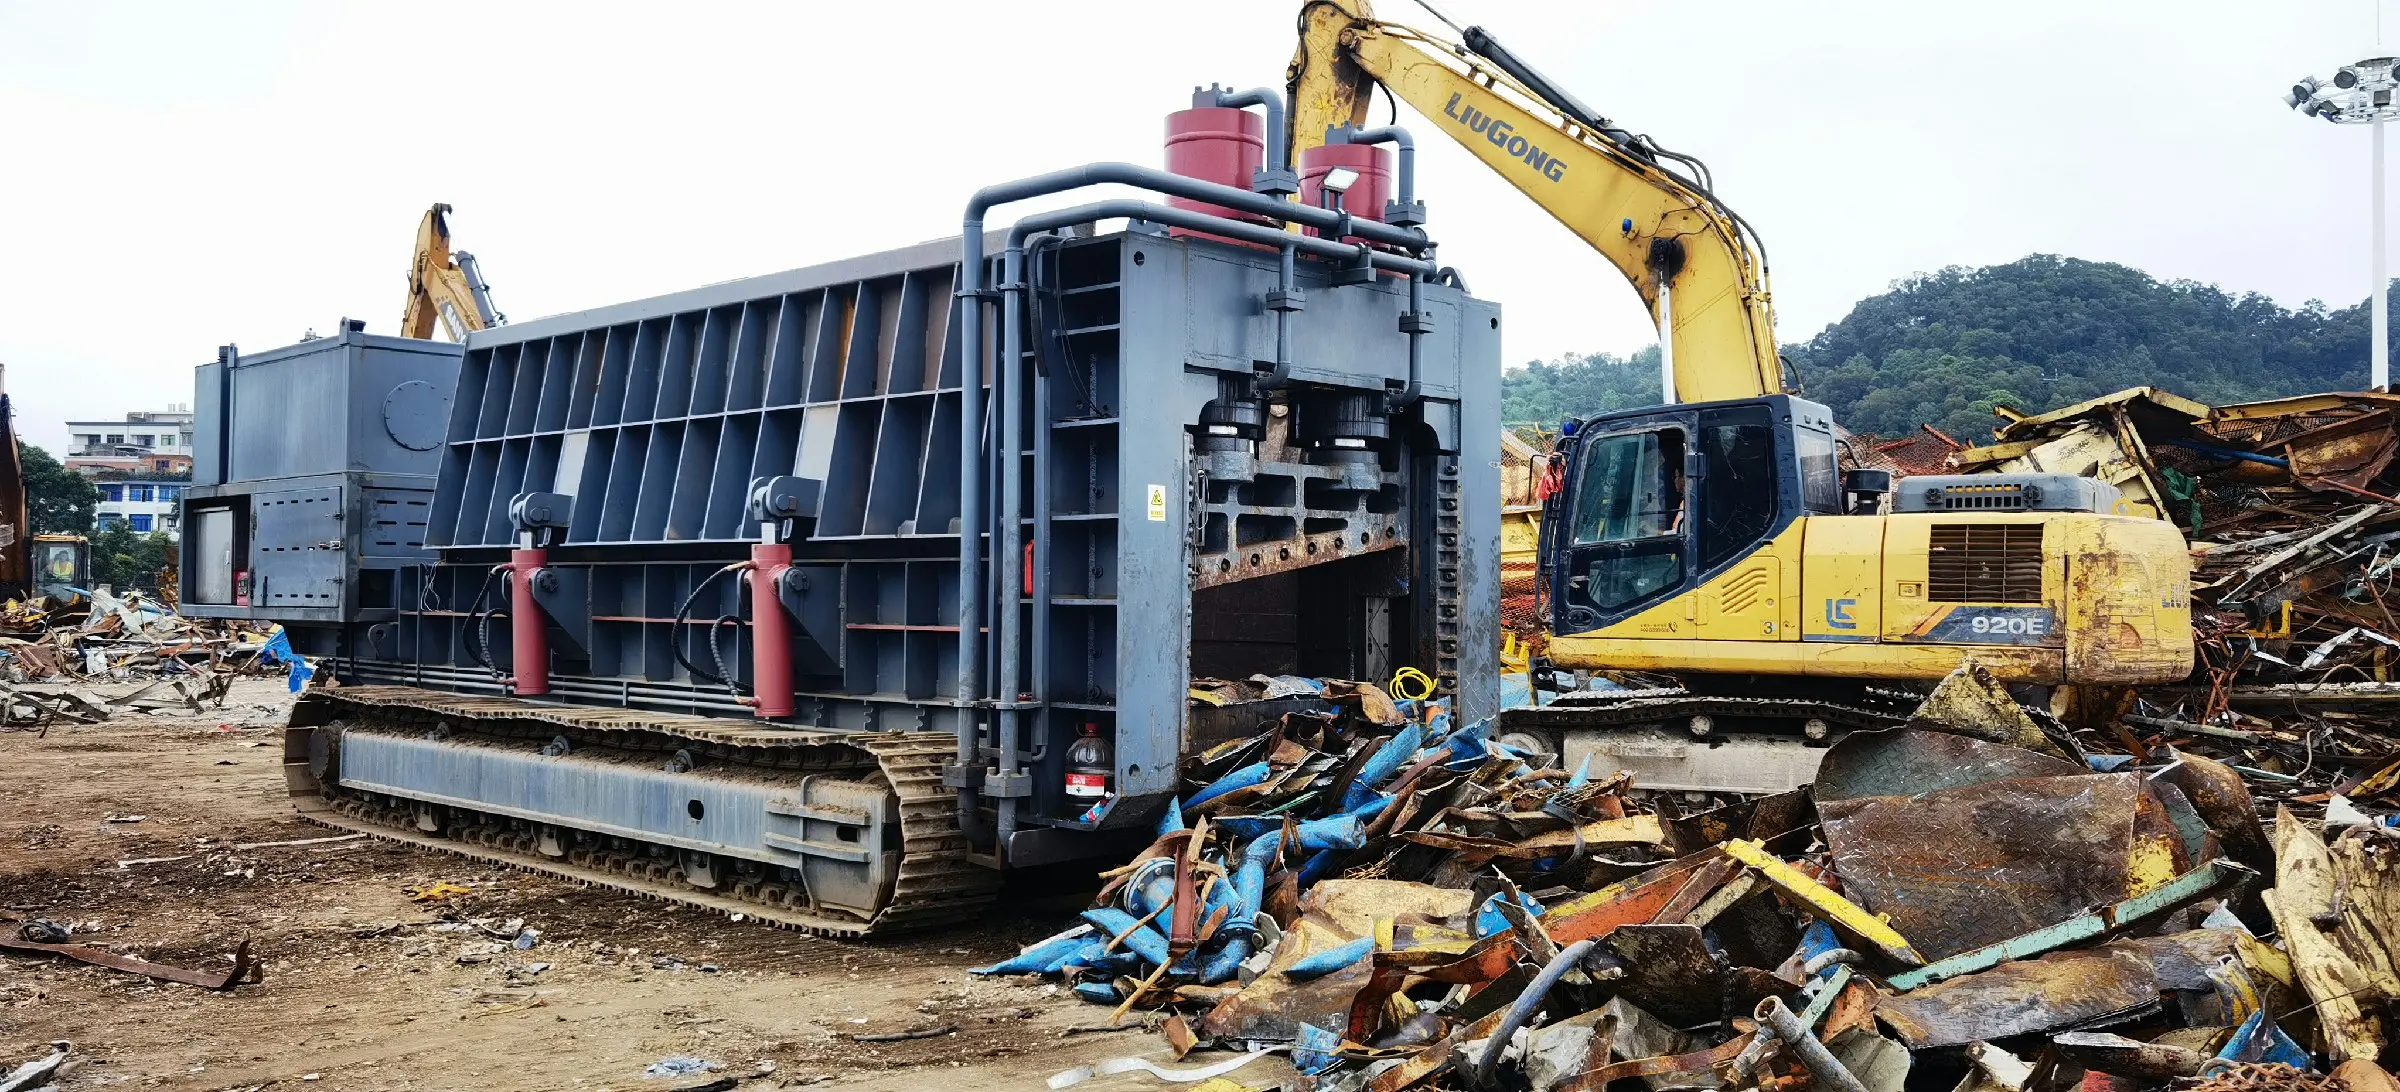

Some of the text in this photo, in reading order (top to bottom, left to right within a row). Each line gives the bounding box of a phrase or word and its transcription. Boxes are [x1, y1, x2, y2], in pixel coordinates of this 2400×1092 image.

[1443, 91, 1568, 183] LIUGONG
[1763, 621, 1773, 635] 3
[1971, 616, 2044, 635] 920E
